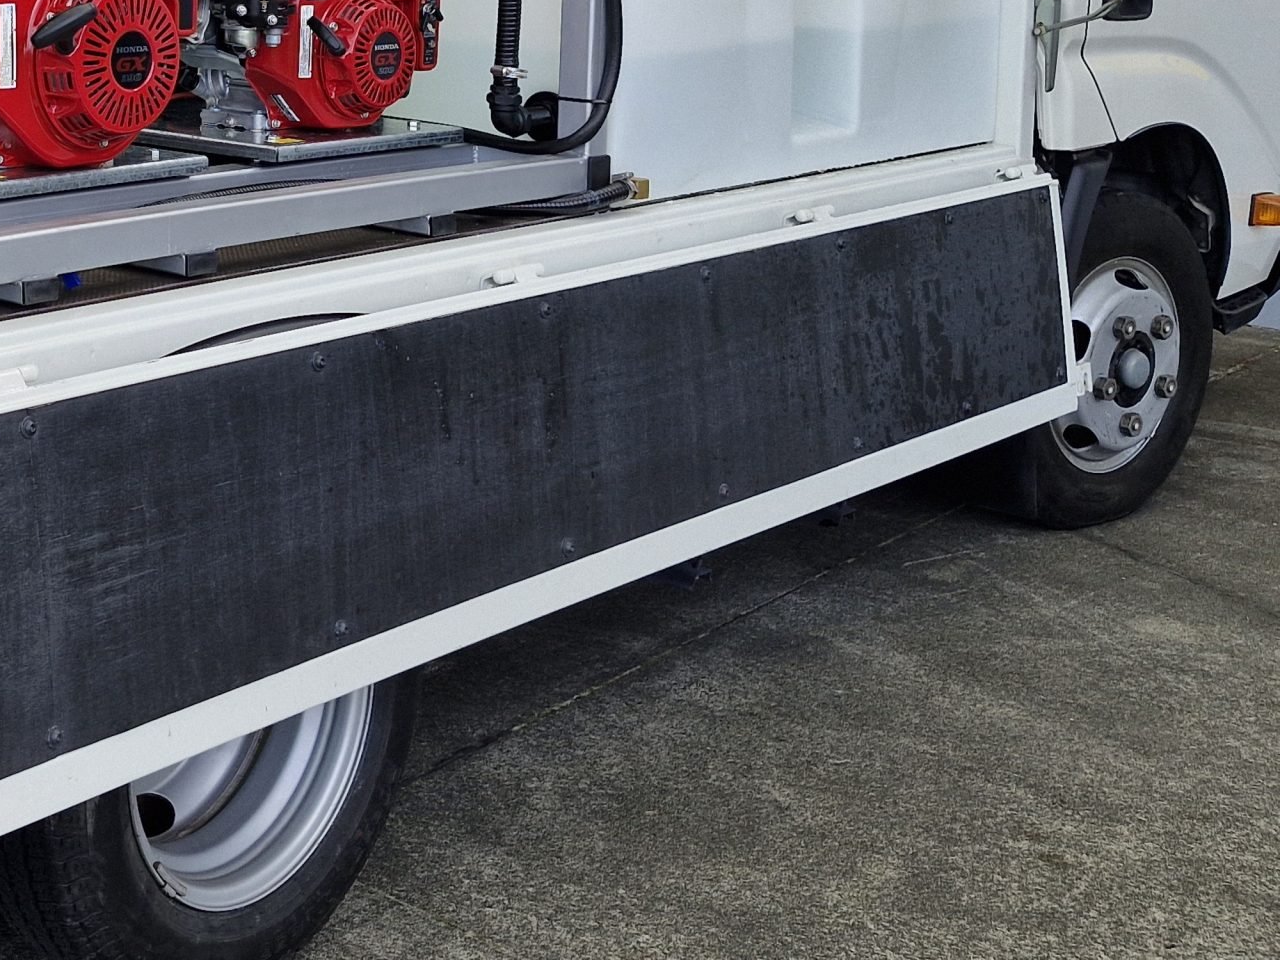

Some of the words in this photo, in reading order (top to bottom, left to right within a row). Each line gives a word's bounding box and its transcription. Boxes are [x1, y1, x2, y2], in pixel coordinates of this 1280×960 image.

[116, 45, 149, 54] HONDA
[374, 43, 399, 51] HONDA
[116, 55, 148, 73] GX
[374, 52, 398, 66] GX
